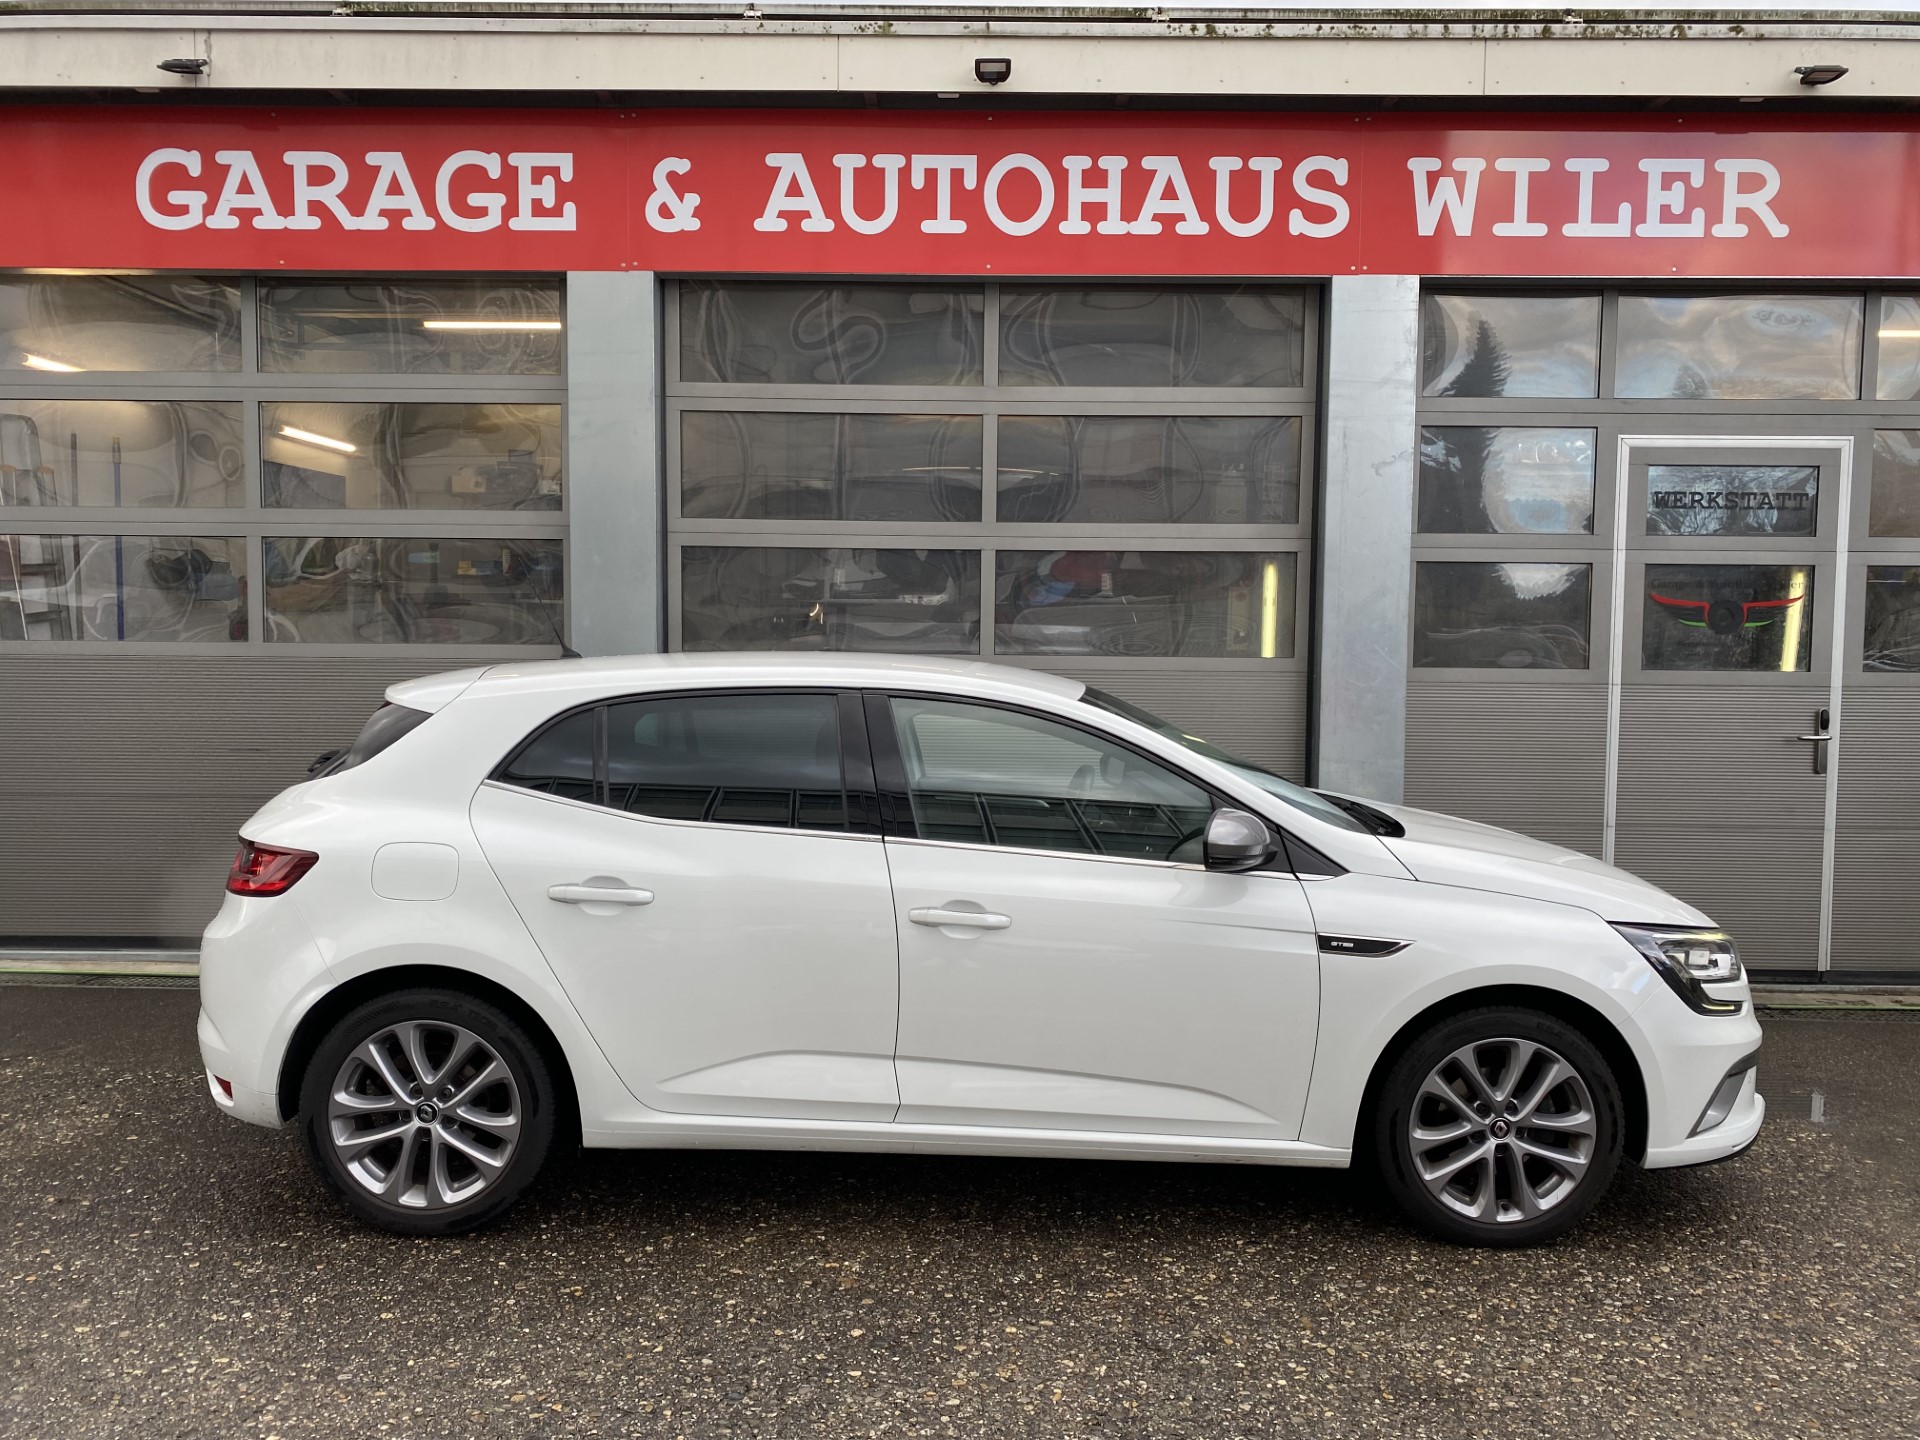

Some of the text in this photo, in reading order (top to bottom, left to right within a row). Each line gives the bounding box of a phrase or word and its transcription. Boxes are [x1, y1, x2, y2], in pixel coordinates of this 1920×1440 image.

[135, 147, 1790, 239] GARAGE & AUTOHAUS WILER
[1653, 491, 1809, 510] WERKSTATT
